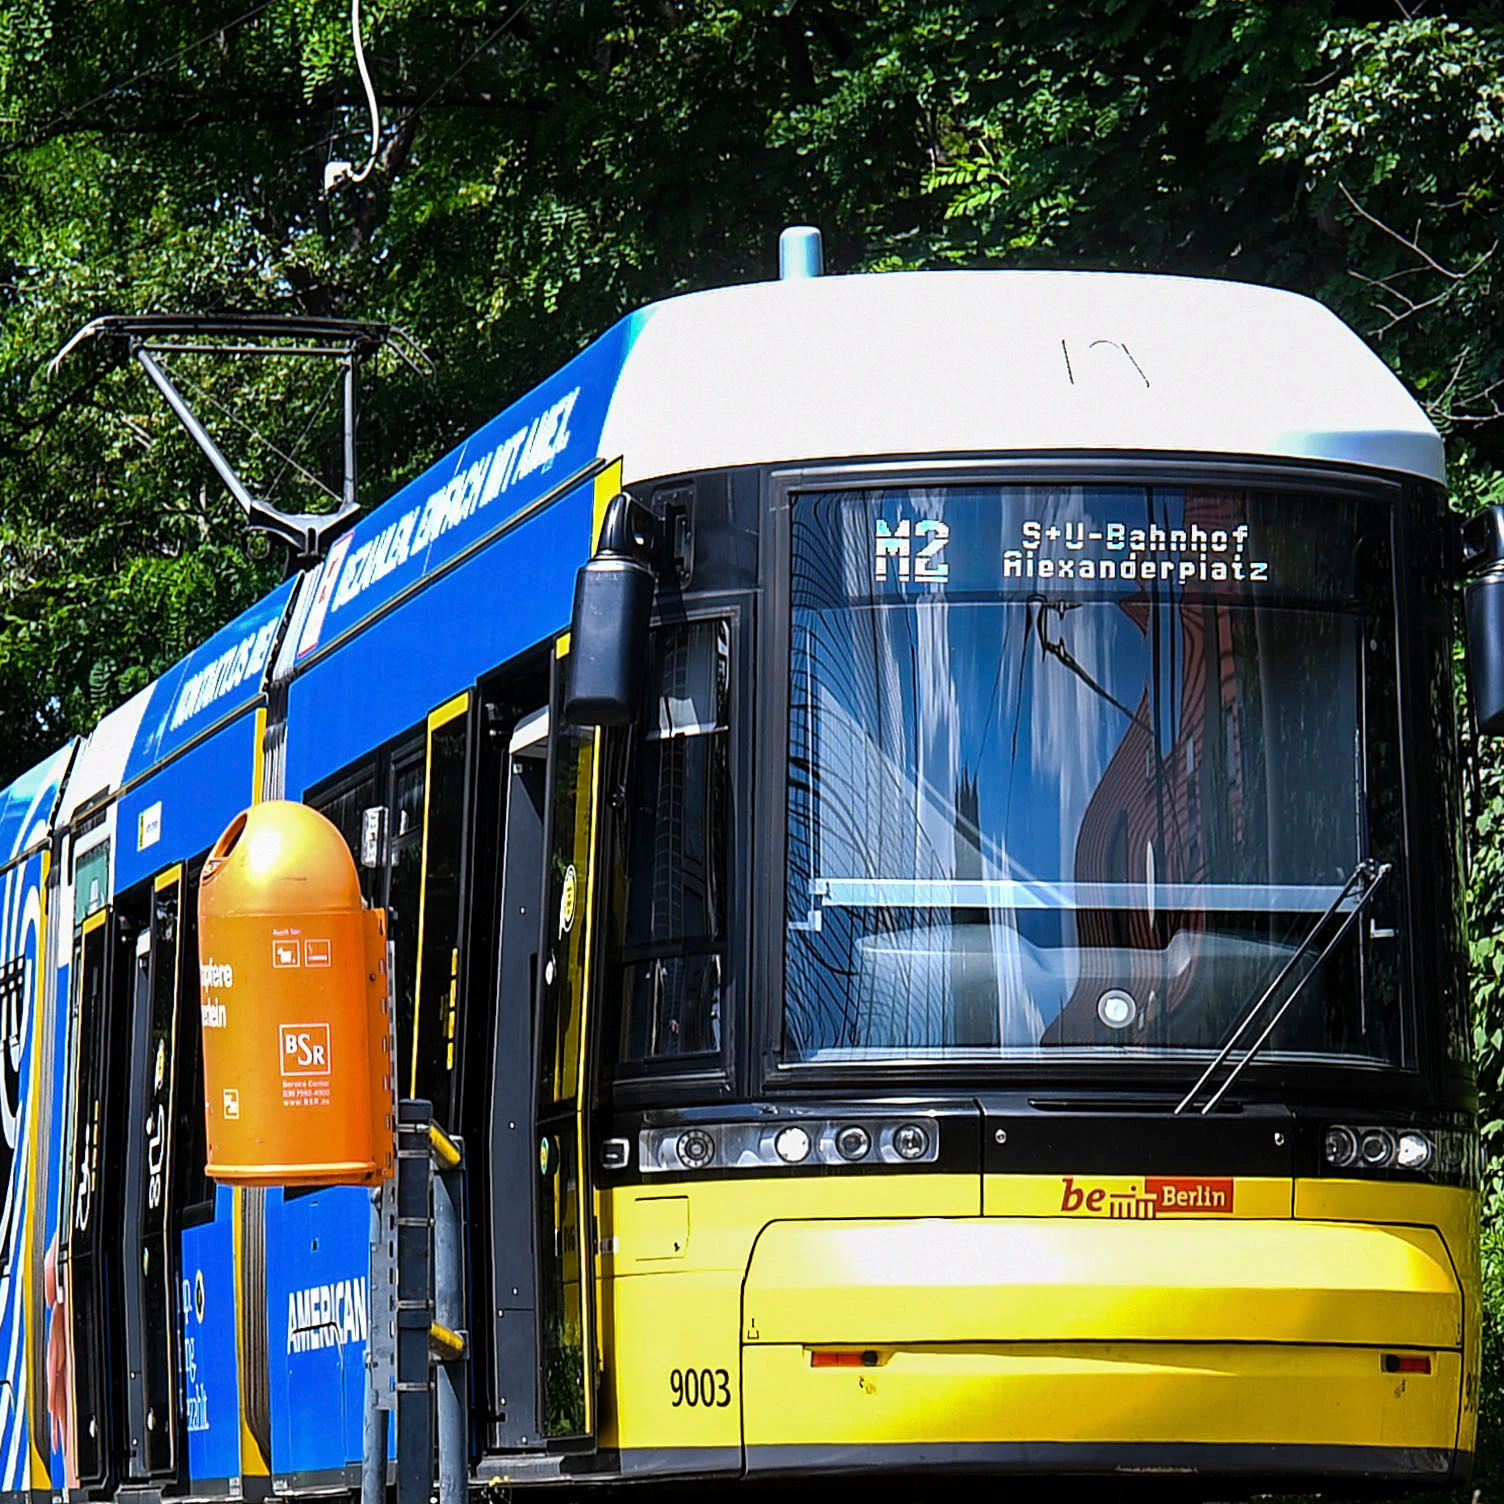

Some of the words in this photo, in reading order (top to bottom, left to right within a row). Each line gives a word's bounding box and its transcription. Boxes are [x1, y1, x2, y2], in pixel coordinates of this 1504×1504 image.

[875, 519, 950, 583] M2
[1021, 521, 1249, 553] S+U-Bahnhof
[1002, 550, 1270, 585] Alexanderplatz
[285, 1033, 326, 1066] BSR
[1061, 1178, 1106, 1212] be
[1161, 1185, 1226, 1207] Berlin
[287, 1276, 367, 1355] AMERICAN
[670, 1368, 731, 1407] 9003
